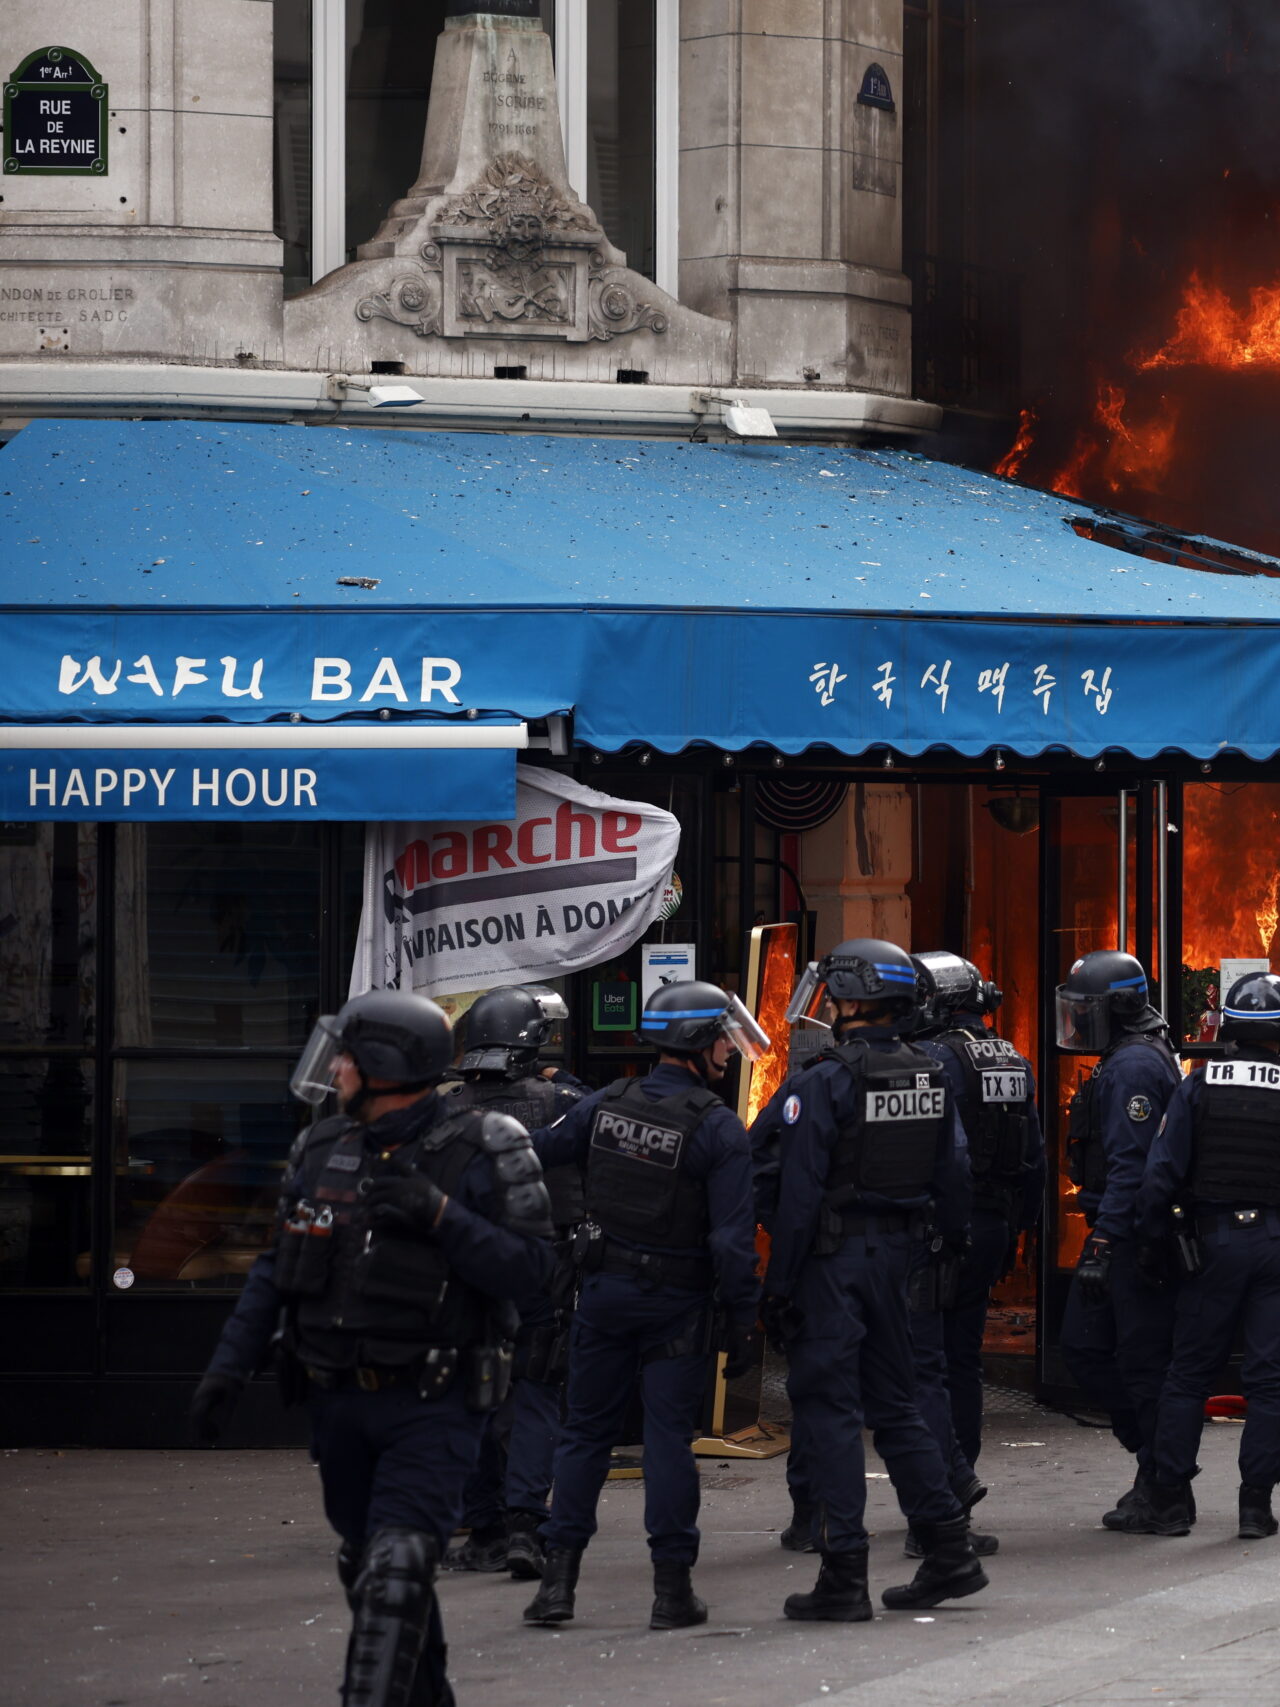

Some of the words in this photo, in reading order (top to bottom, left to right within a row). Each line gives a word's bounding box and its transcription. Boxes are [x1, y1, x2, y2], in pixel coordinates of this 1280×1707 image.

[40, 100, 71, 115] RUE
[497, 95, 545, 110] SCRIBE
[47, 121, 64, 133] DE
[15, 139, 35, 154] LA
[40, 139, 95, 154] REYNIE
[47, 291, 62, 300] DE
[67, 288, 134, 301] GROLIER
[58, 655, 264, 699] WAFU
[310, 656, 463, 703] BAR
[28, 768, 176, 807] HAPPY
[192, 768, 318, 807] HOUR
[535, 905, 556, 938] À
[604, 993, 625, 1004] Uber
[604, 1003, 625, 1013] Eats
[970, 1041, 1021, 1059] POLICE
[1210, 1064, 1235, 1081] TR
[983, 1076, 1004, 1097] TX
[875, 1091, 942, 1118] POLICE
[598, 1115, 678, 1154] POLICE
